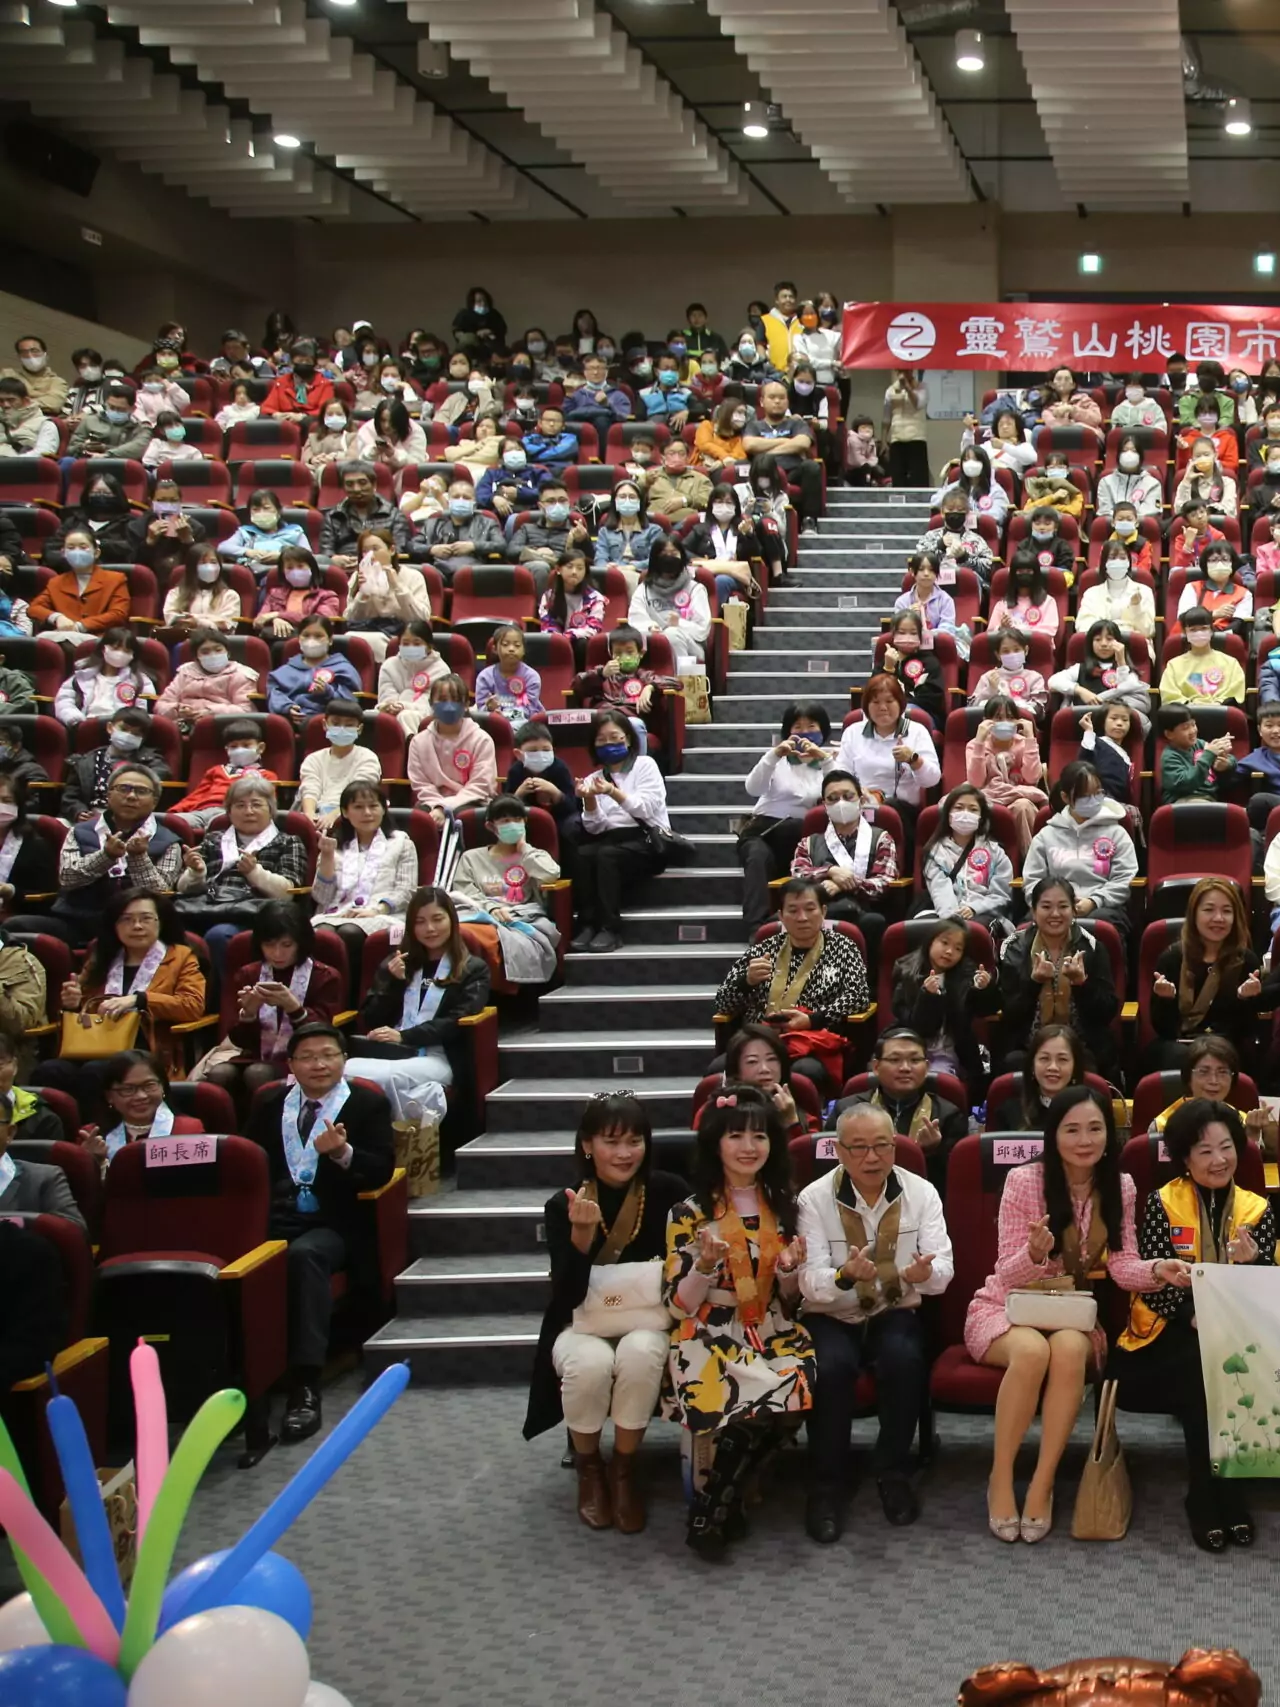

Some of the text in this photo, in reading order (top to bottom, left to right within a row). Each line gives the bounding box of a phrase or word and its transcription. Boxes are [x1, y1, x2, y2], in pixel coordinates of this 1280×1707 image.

[150, 1141, 210, 1163] 師長席
[996, 1144, 1041, 1159] 邱議長
